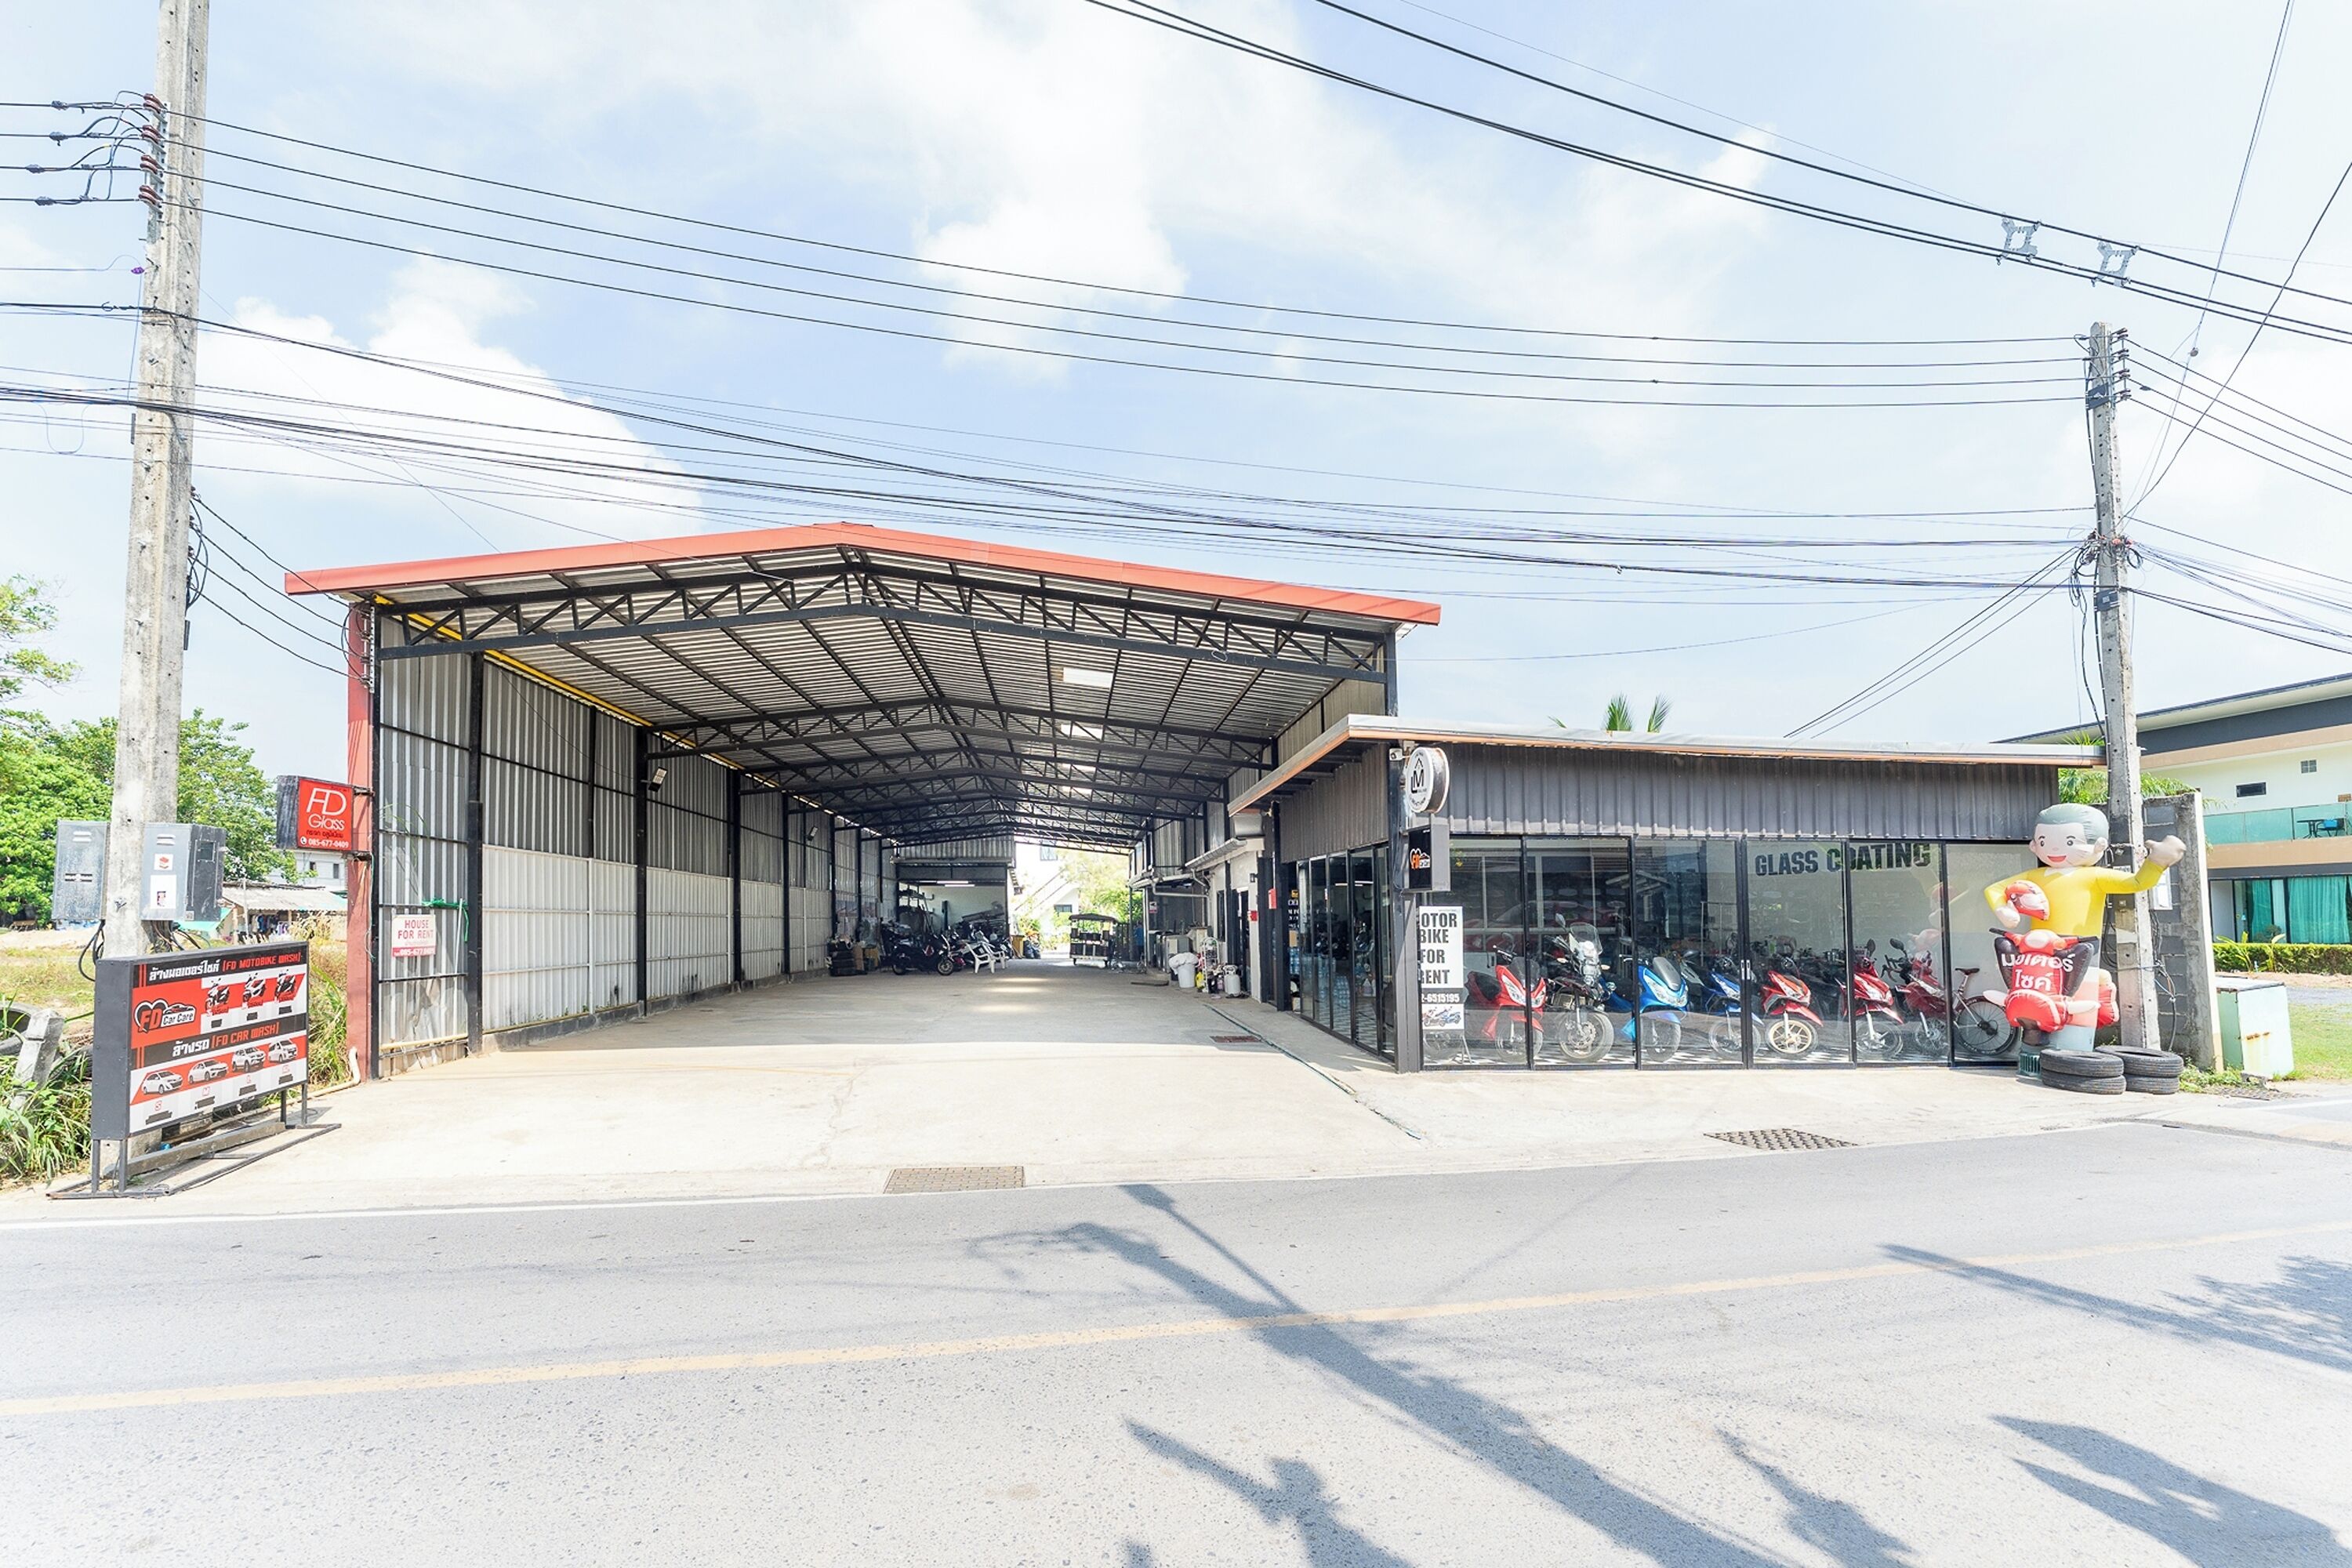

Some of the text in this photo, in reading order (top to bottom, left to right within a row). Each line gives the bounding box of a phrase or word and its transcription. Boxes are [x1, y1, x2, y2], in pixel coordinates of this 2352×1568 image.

[308, 814, 345, 830] Glass
[308, 838, 349, 848] 085-677-0409
[1755, 850, 1818, 876] GLASS
[405, 920, 429, 929] HOUSE
[1421, 913, 1457, 927] OTOR
[397, 930, 434, 939] FOR RENT
[1420, 929, 1449, 943] BIKE
[239, 955, 276, 970] MOTOBIKE
[1421, 949, 1445, 964] FOR
[2001, 953, 2075, 972] มอเตอร์
[2015, 969, 2054, 991] ไซค์
[140, 1009, 162, 1029] FD
[163, 1012, 194, 1025] Car Care
[230, 1030, 249, 1044] CAR
[154, 1101, 162, 1111] S
